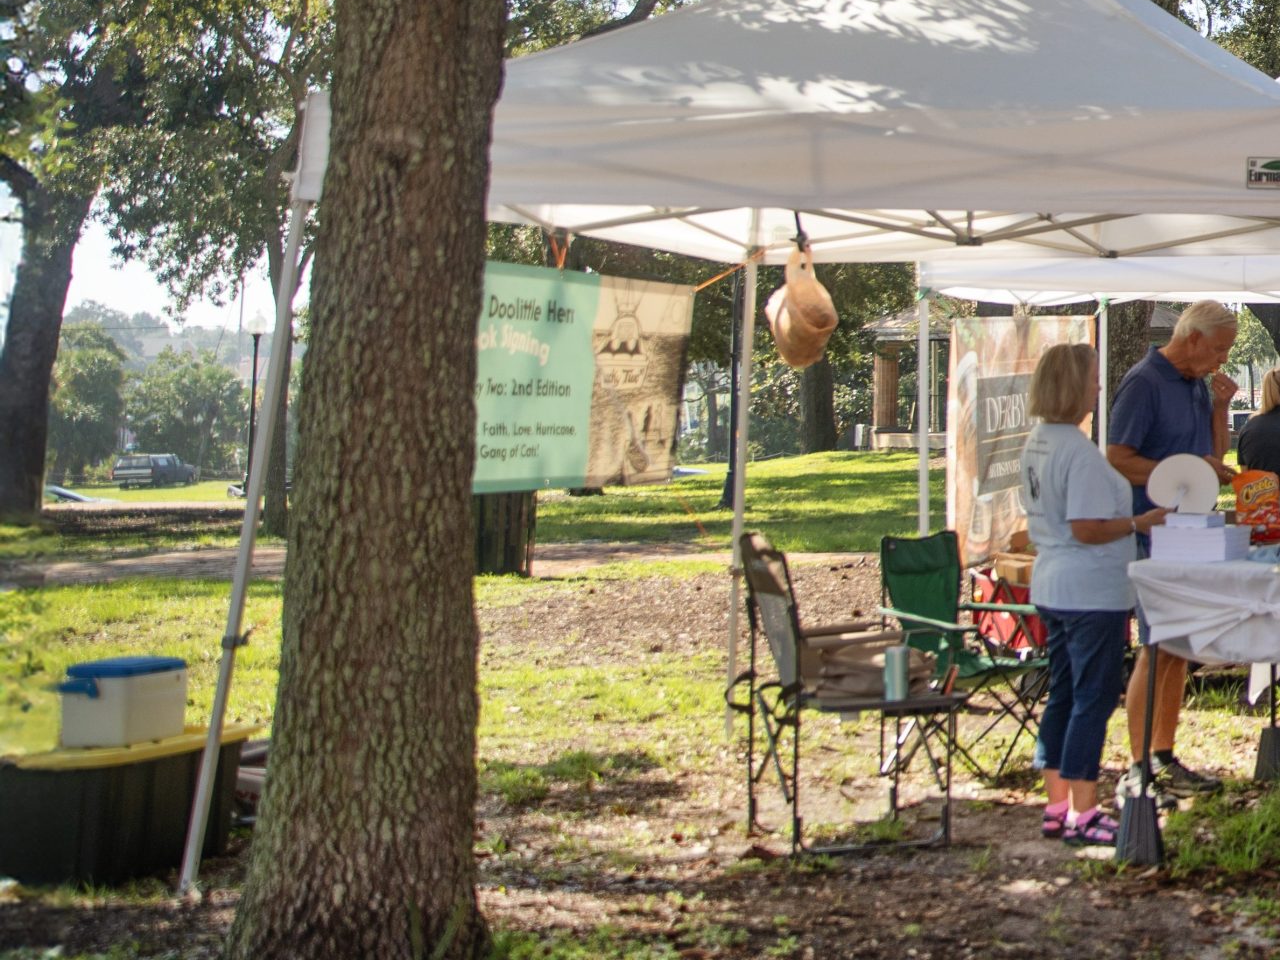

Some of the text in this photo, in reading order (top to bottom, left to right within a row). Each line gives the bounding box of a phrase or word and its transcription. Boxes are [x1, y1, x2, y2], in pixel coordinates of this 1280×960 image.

[488, 294, 542, 321] Doolittle
[501, 323, 550, 366] Signing
[487, 378, 507, 396] Two:
[511, 378, 533, 396] 2nd
[536, 378, 571, 397] Edition
[480, 444, 507, 462] Gang
[510, 443, 519, 457] of
